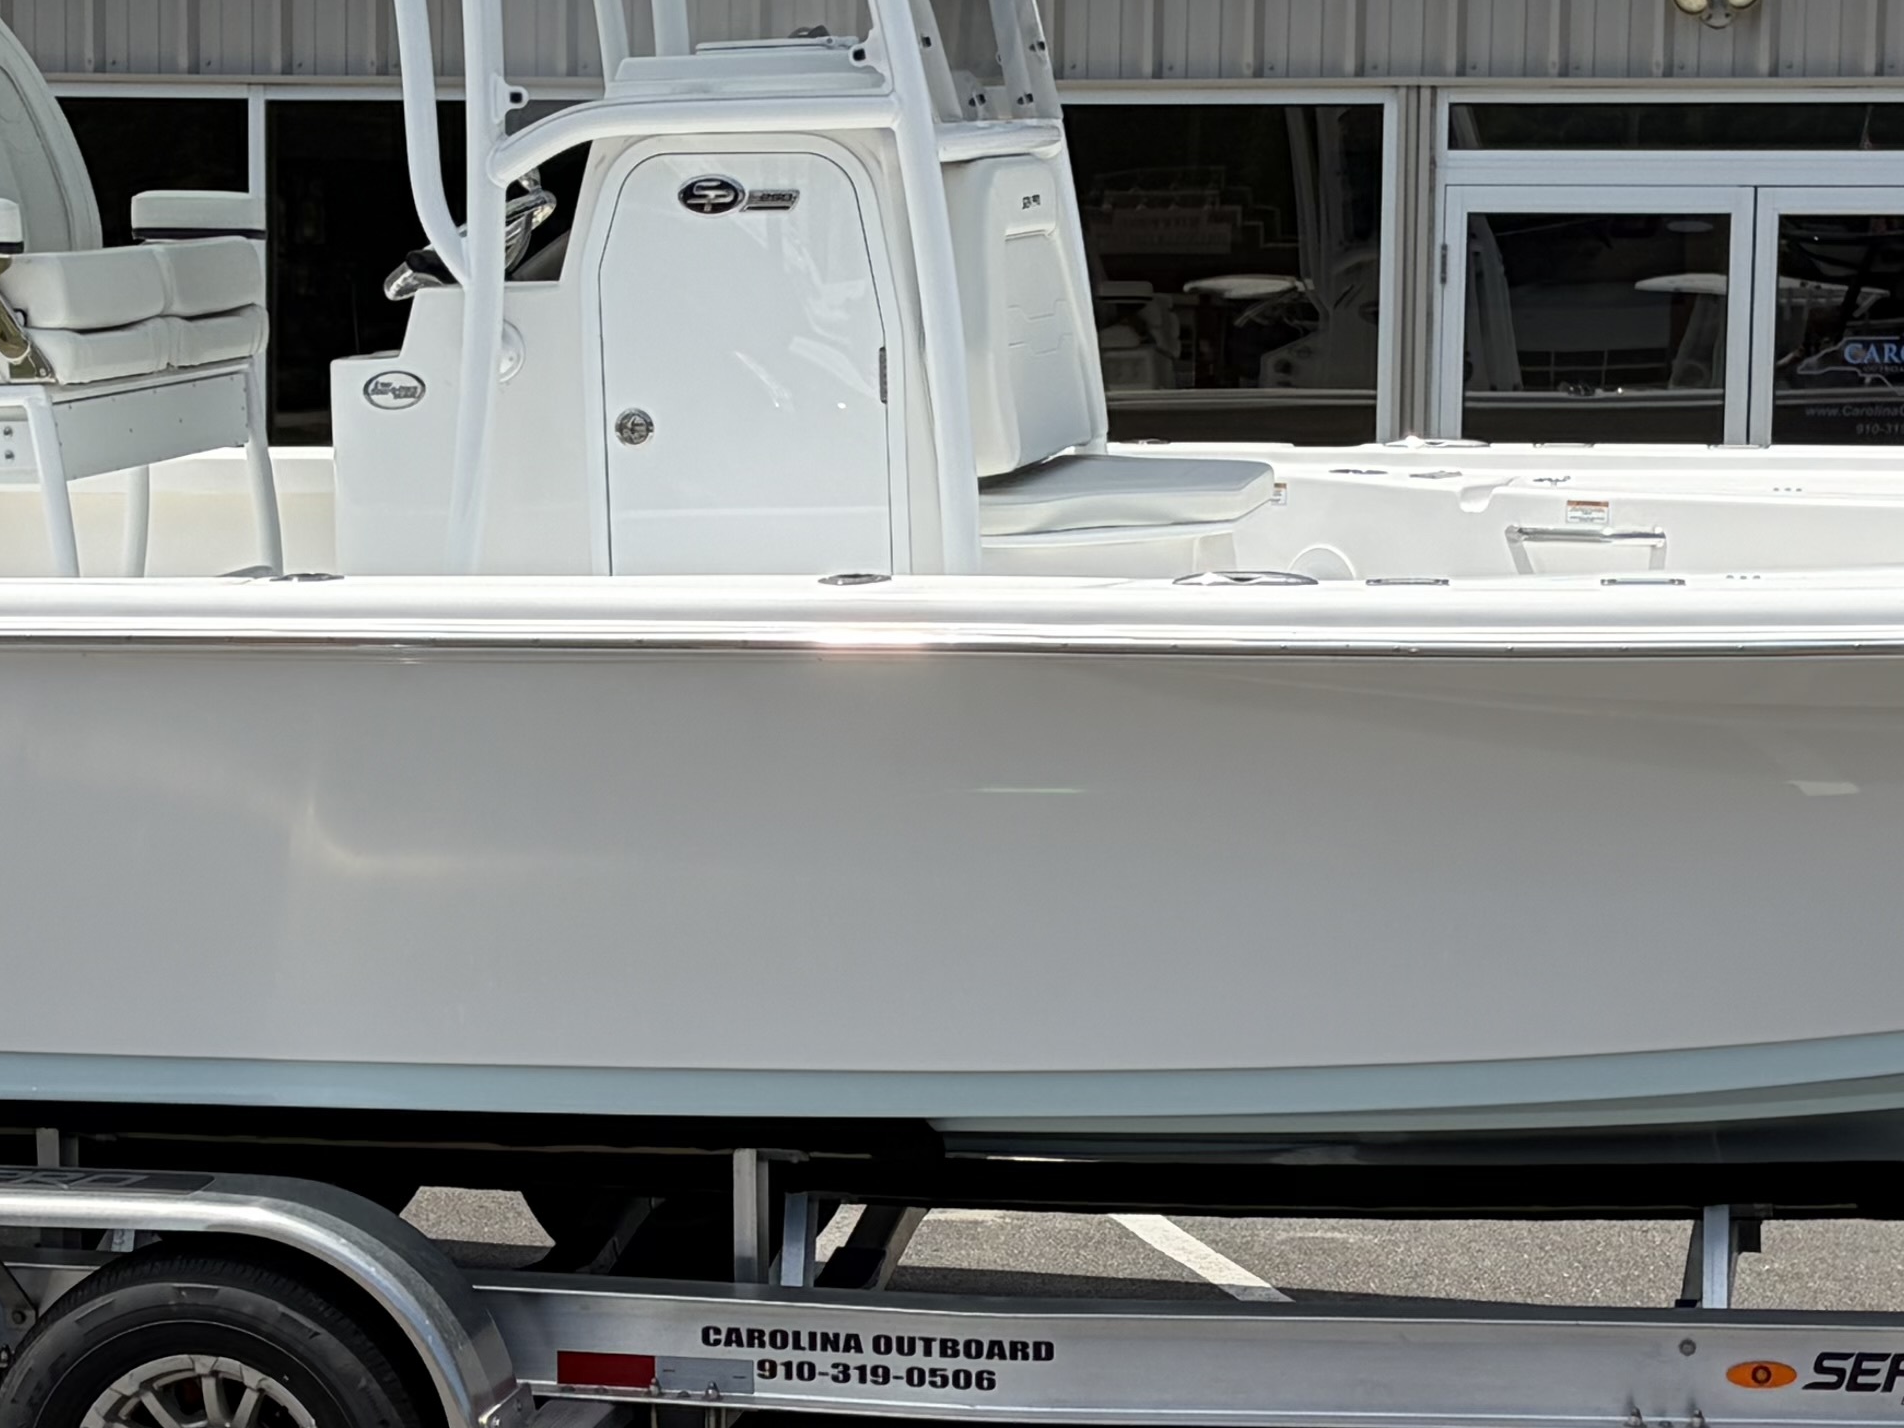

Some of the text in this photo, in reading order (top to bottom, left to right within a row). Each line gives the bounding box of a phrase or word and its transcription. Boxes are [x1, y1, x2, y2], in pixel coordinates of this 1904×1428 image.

[701, 1326, 1055, 1361] CAROLINA OUTBOARD
[756, 1359, 996, 1391] 910-319-0506
